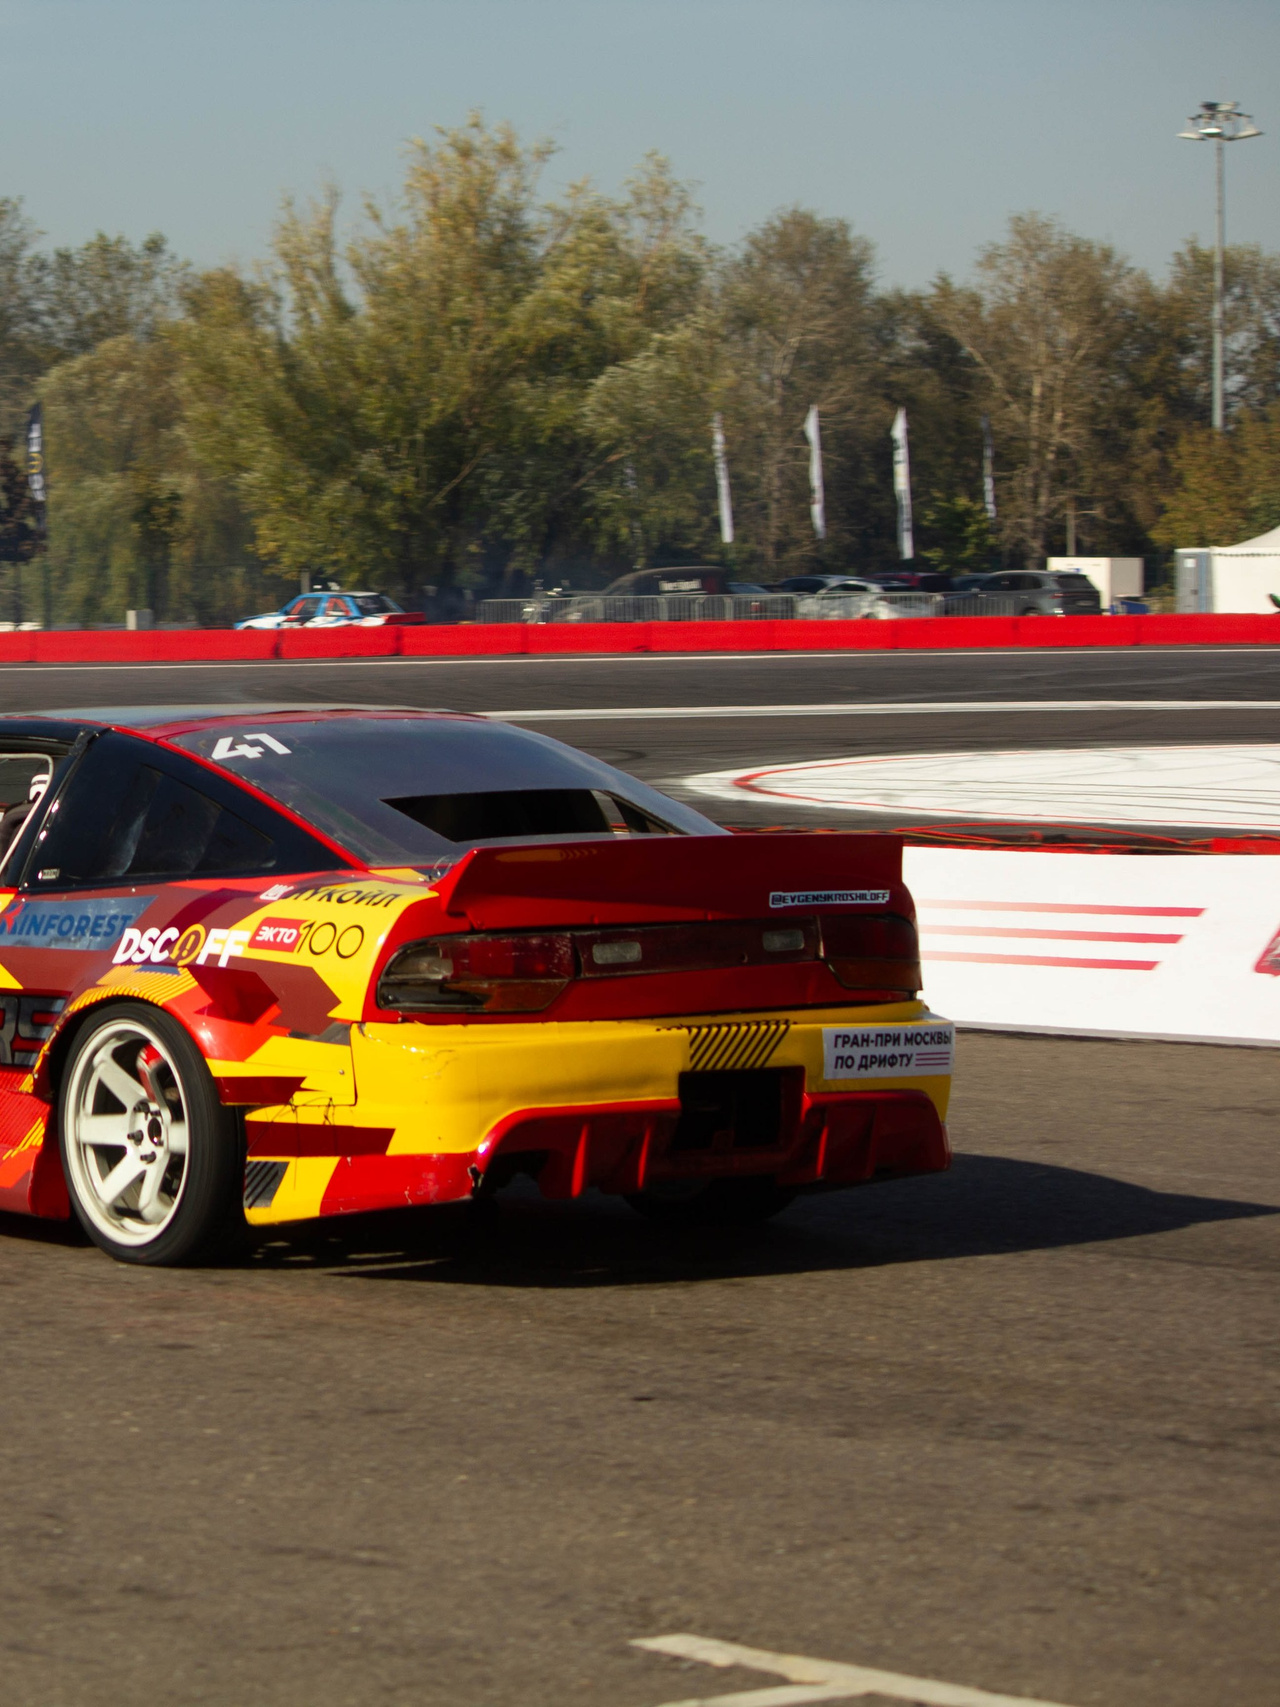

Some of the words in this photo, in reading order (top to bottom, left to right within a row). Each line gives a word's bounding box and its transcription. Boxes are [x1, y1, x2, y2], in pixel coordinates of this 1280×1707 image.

[211, 733, 293, 760] 41
[255, 925, 298, 944] ЭКТО
[296, 920, 365, 960] 100
[833, 1033, 901, 1048] ГРАН-ПРИ
[904, 1031, 952, 1047] МОСКВЫ
[834, 1055, 855, 1069] ПО
[857, 1053, 913, 1071] ДРИФТУ
